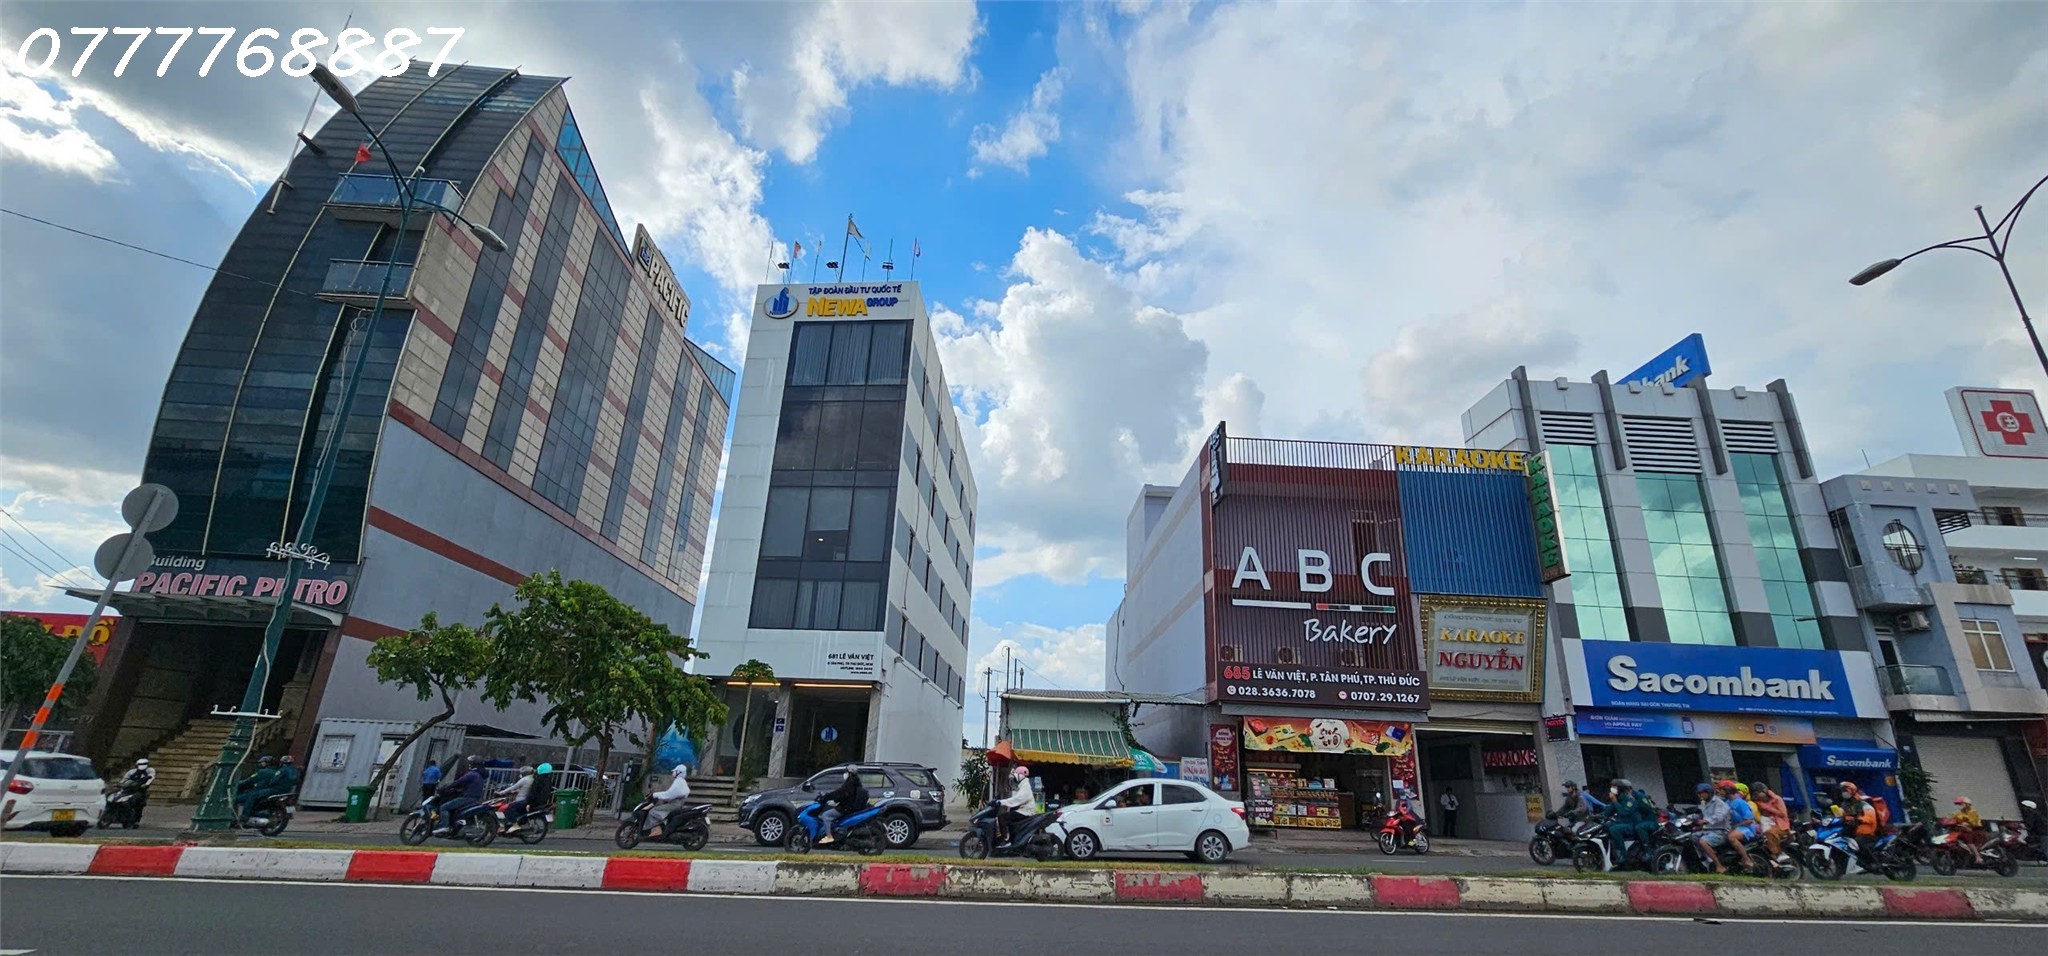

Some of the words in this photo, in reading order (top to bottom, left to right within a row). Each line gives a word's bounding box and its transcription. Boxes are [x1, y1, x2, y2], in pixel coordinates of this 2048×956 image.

[648, 253, 689, 328] PACIFIC
[807, 296, 868, 317] NEWA
[866, 297, 898, 307] GROUP
[1395, 445, 1526, 471] KARAOKE
[1527, 455, 1560, 569] KARAOKE
[131, 571, 248, 597] PACIFIC
[1303, 618, 1397, 645] Bakery
[1439, 627, 1526, 646] KARAOKE
[1438, 648, 1524, 671] NGUYỄN
[1223, 666, 1251, 680] 685
[1252, 668, 1264, 679] LÊ
[1265, 668, 1285, 680] VĂN
[1286, 669, 1309, 683] VIỆT,
[1310, 672, 1319, 682] P.
[1319, 671, 1339, 683] TÂN
[1378, 672, 1397, 685] THỦ
[1398, 673, 1420, 686] ĐỨC
[1607, 655, 1835, 701] Sacombank
[1238, 686, 1316, 699] 028.3636.7078
[1350, 691, 1420, 703] 0707.29.1267
[1483, 749, 1537, 767] KARAOKE
[1826, 754, 1892, 769] Sacombank
